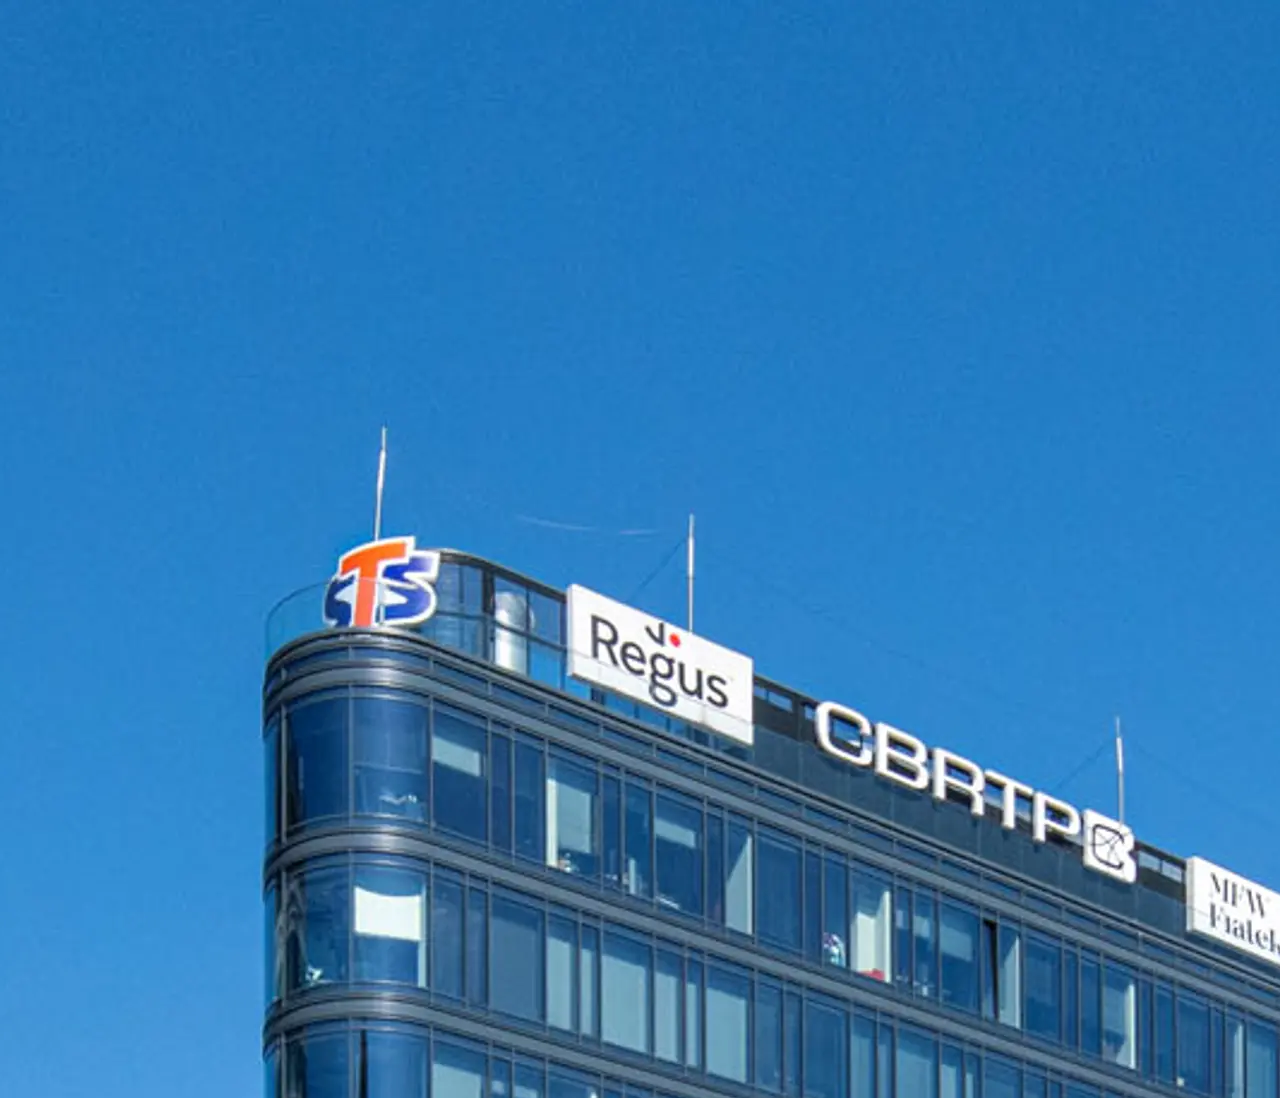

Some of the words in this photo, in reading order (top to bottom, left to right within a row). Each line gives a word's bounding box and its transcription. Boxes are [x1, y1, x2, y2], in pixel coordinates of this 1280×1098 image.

[323, 536, 440, 628] STS
[590, 613, 729, 709] Regus
[814, 700, 1081, 844] CBRTP
